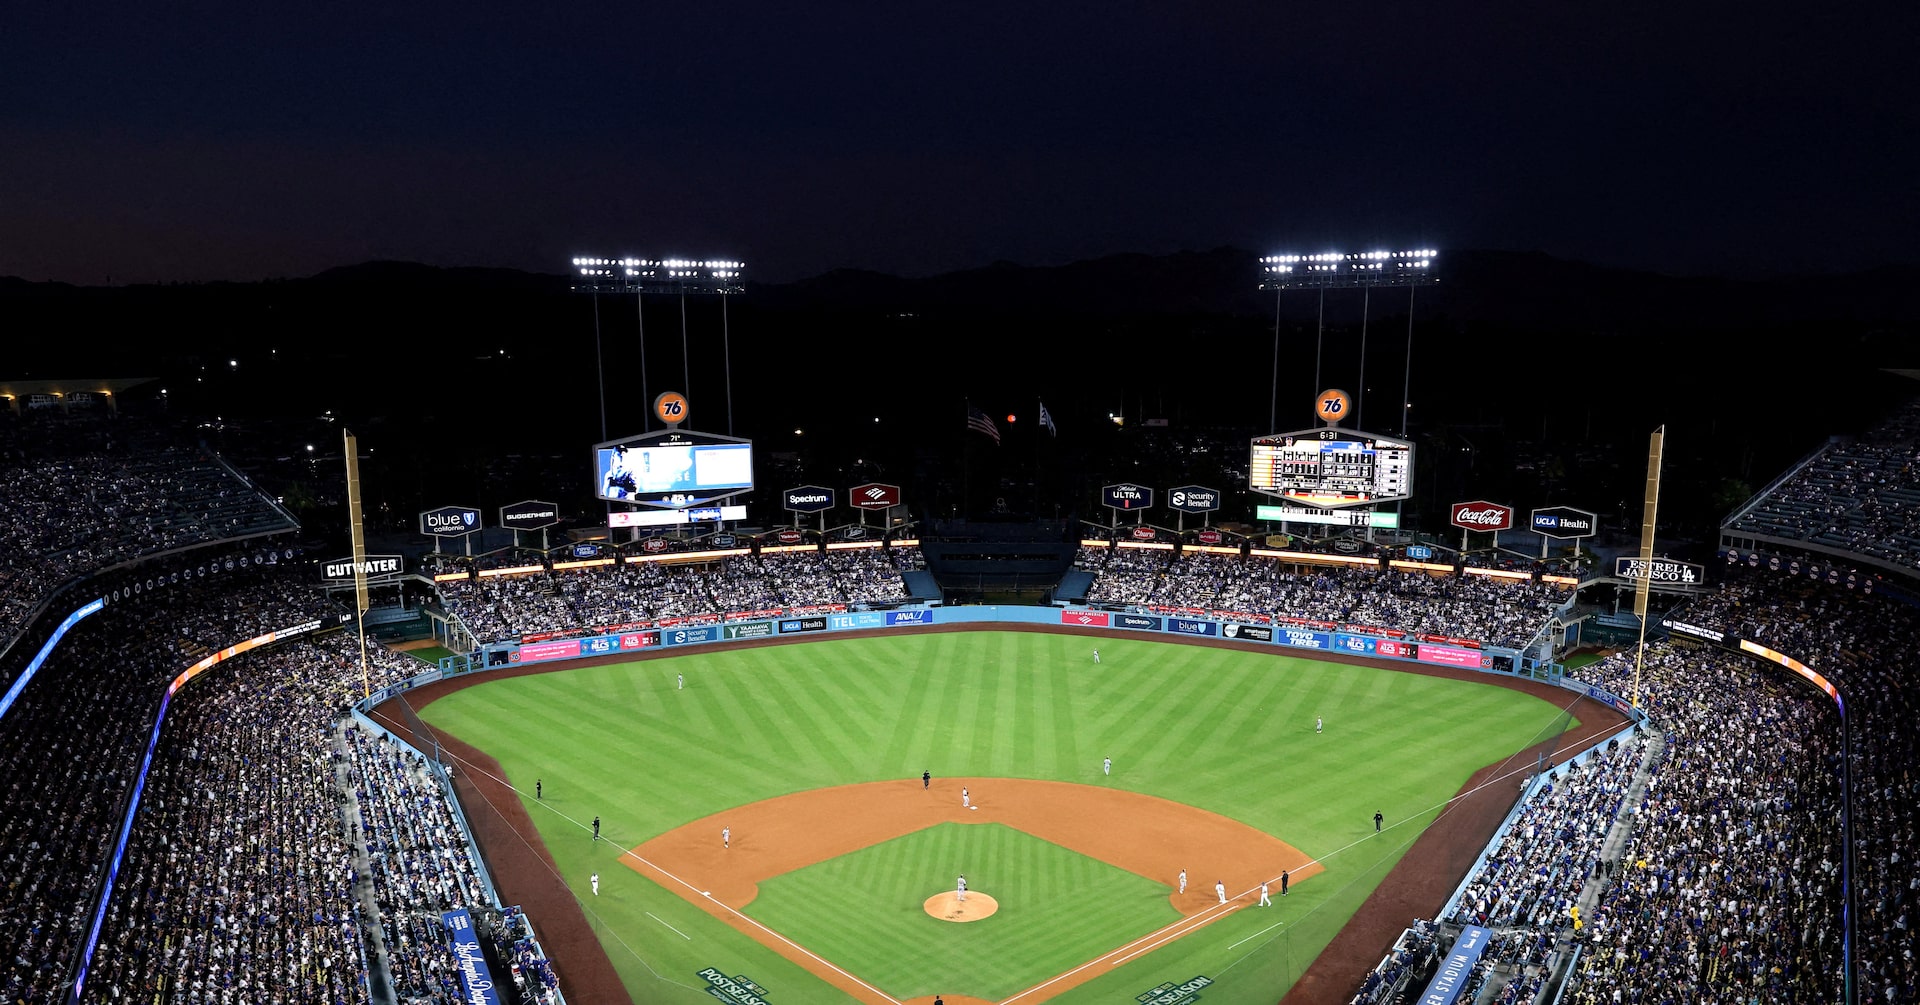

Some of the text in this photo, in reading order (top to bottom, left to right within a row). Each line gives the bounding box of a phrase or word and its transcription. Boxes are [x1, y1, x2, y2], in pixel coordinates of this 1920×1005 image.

[663, 400, 682, 416] 76
[1322, 398, 1342, 413] 76
[1320, 431, 1338, 440] 6:31
[1113, 491, 1141, 499] ULTRA
[1187, 492, 1215, 501] Security
[789, 495, 827, 505] Spectrum
[1187, 499, 1211, 508] Benefit
[427, 513, 461, 527] blue
[506, 511, 554, 520] GUGGENHEIM
[1456, 507, 1506, 526] Coca-Cola
[1535, 517, 1589, 529] UCLA Health
[433, 524, 465, 533] california
[1410, 548, 1428, 557] TEL
[327, 558, 397, 578] CUTWATER
[1623, 568, 1679, 581] JALISCO
[895, 612, 914, 621] ANA
[802, 620, 823, 628] Health
[833, 617, 855, 627] TEL
[1178, 621, 1198, 631] blue
[687, 629, 709, 637] Security
[1285, 630, 1314, 639] TOYO
[592, 642, 609, 650] NLCS
[1289, 638, 1321, 648] TIRES
[1347, 640, 1365, 649] NLCS
[1435, 954, 1469, 993] STADIUM
